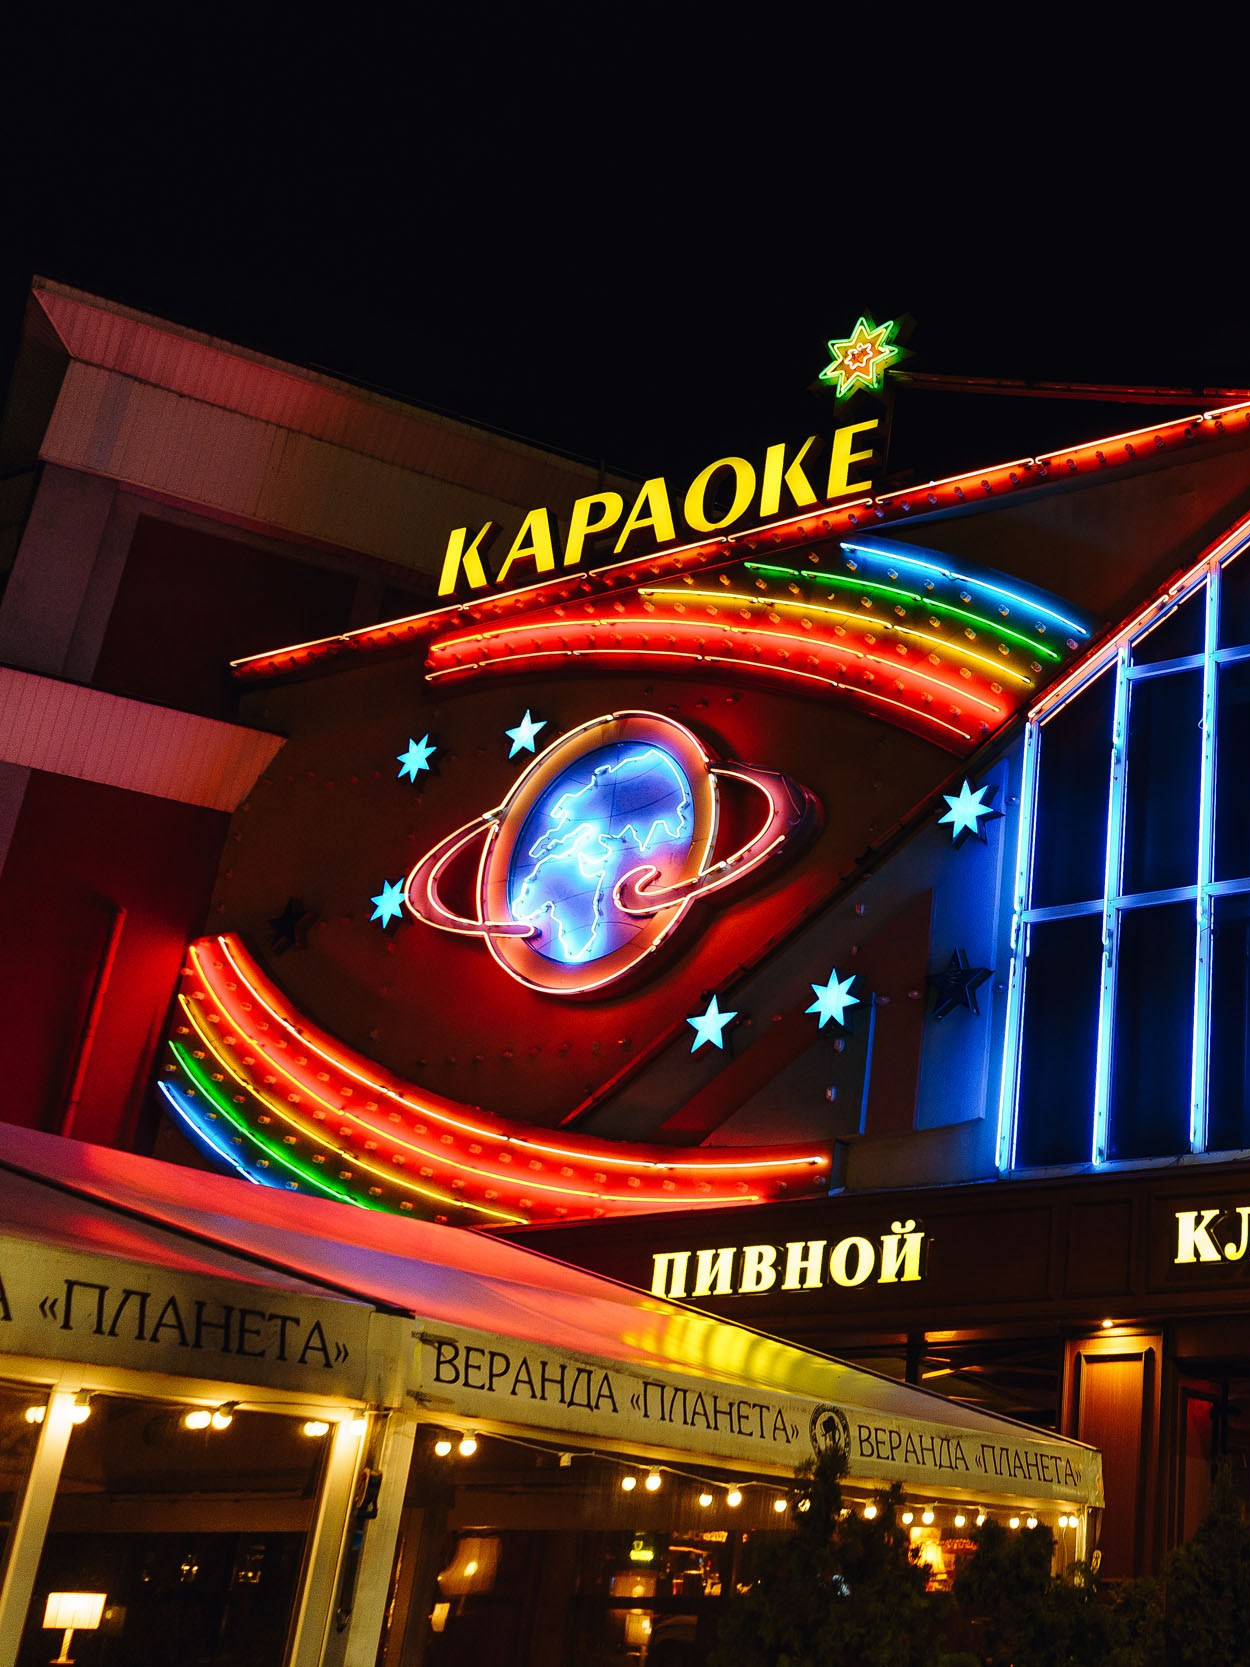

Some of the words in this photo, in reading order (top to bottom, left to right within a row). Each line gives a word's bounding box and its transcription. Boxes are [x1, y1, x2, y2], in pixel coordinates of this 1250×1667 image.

[437, 419, 878, 597] КАРАОКЕ
[651, 1219, 925, 1299] ПИВНОЙ
[39, 1279, 349, 1369] «ПЛАНЕТА»
[433, 1341, 619, 1414] ВЕРАНДА
[630, 1381, 800, 1443] «ПЛАНЕТА»
[858, 1424, 969, 1472] ВЕРАНДА
[975, 1444, 1082, 1486] «ПЛАНЕТА»
